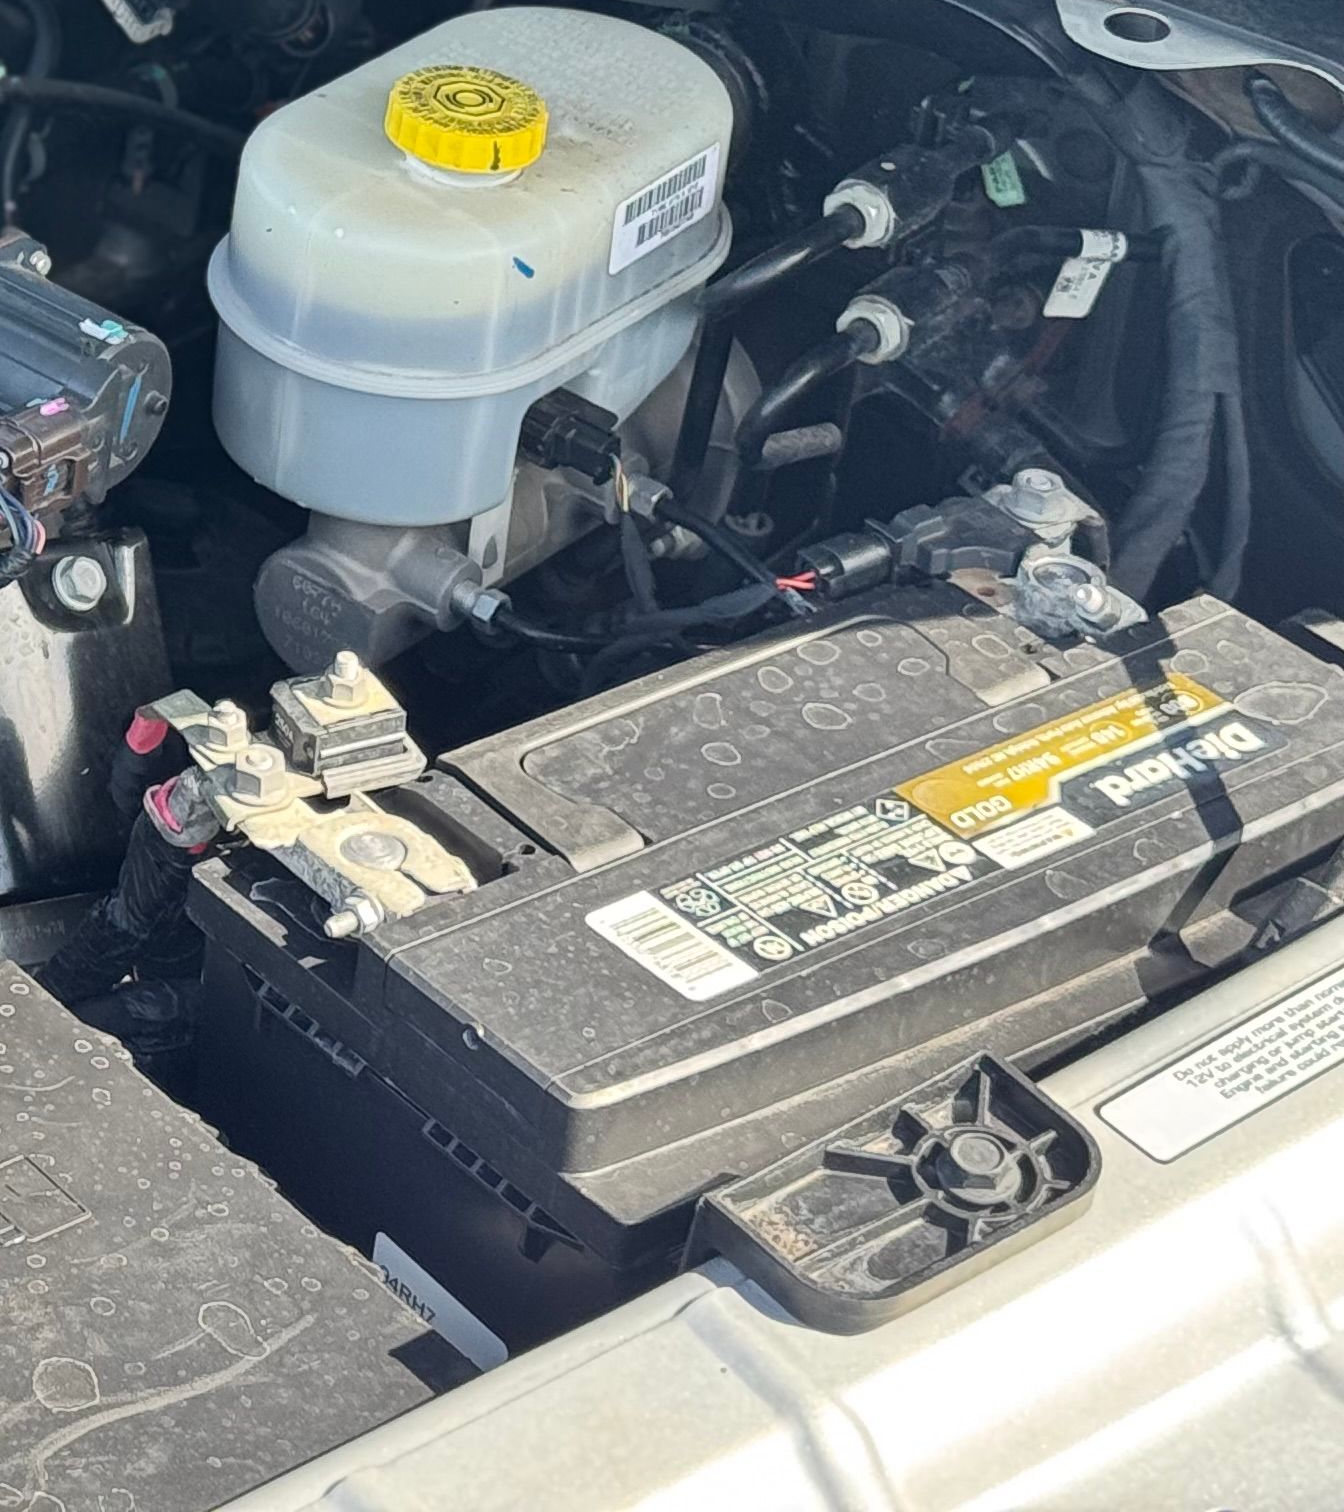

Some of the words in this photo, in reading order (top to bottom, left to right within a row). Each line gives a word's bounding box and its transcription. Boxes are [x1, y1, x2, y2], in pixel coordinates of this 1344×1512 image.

[1095, 721, 1267, 807] DieHard
[950, 794, 1013, 829] GOLD
[799, 872, 960, 948] DANGER/POISON
[1172, 1068, 1194, 1081] Do
[1194, 1053, 1218, 1069] not
[1217, 1035, 1252, 1058] apply
[1251, 1016, 1286, 1037] more
[1282, 998, 1315, 1018] than
[1185, 1069, 1216, 1088] 12V
[1214, 1060, 1232, 1073] to
[1232, 1027, 1288, 1063] electrical
[1287, 1003, 1334, 1031] system
[1213, 1054, 1270, 1089] charging
[1267, 1045, 1283, 1057] or
[1283, 1028, 1315, 1049] jump
[1219, 1073, 1265, 1100] Engine
[1264, 1056, 1289, 1075] and
[1289, 1031, 1341, 1060] starting
[1255, 1069, 1298, 1094] failure
[1296, 1048, 1331, 1071] could
